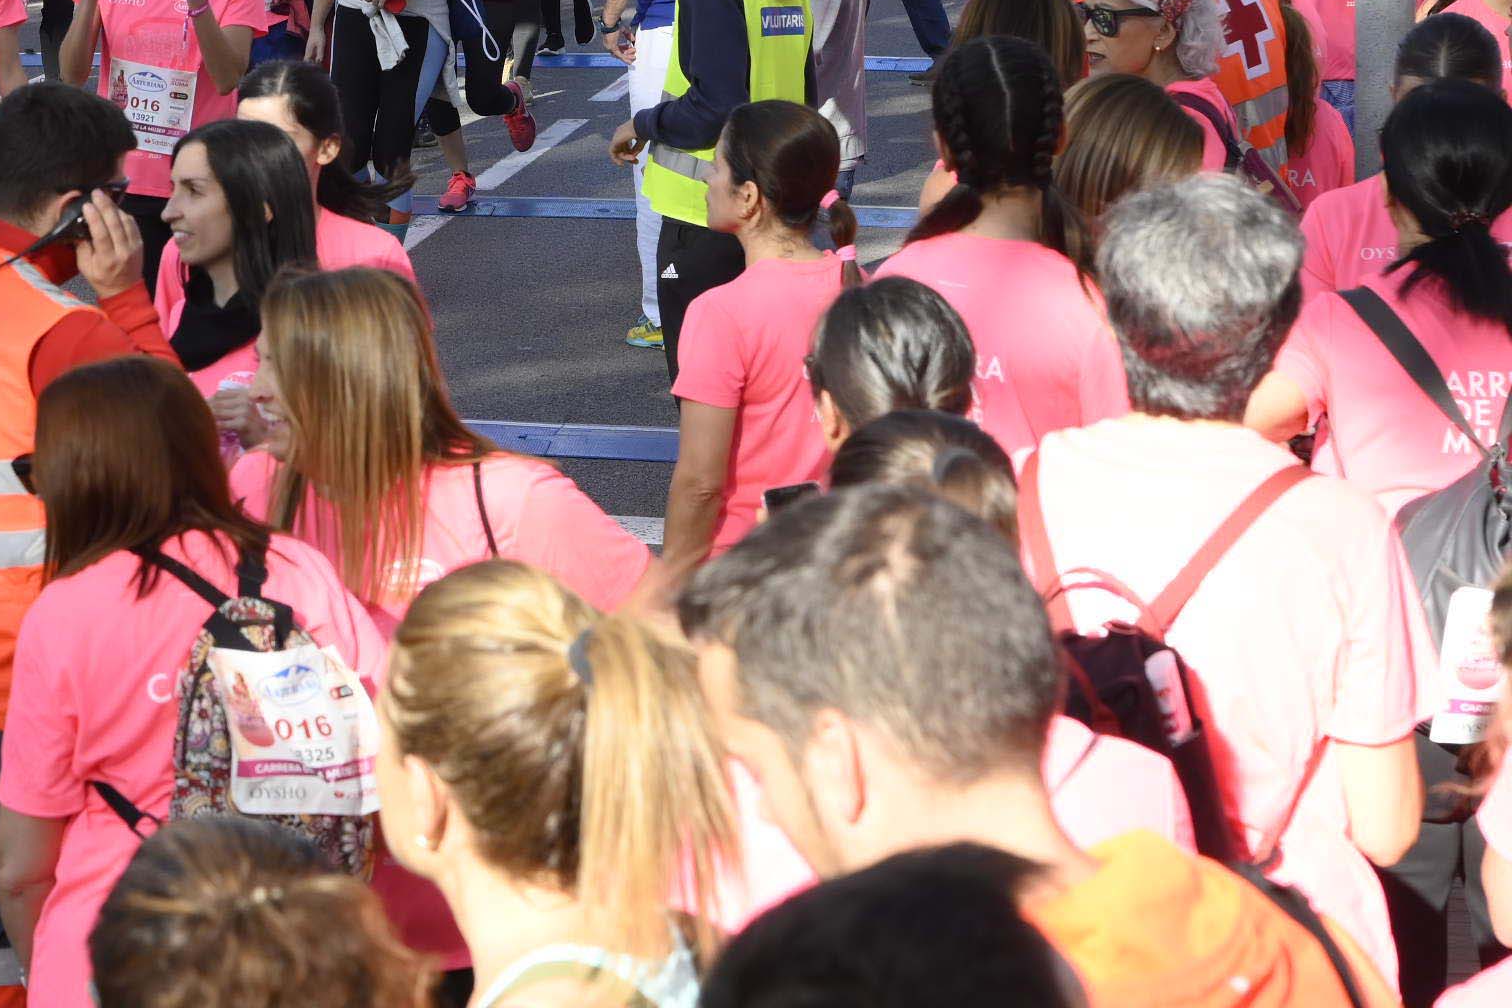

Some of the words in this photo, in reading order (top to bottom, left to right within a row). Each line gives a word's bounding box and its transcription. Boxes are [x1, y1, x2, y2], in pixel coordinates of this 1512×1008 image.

[131, 96, 160, 112] 016
[131, 112, 155, 123] 13921
[1360, 246, 1396, 261] OYS
[275, 715, 332, 741] 016
[249, 784, 307, 801] OYSHO
